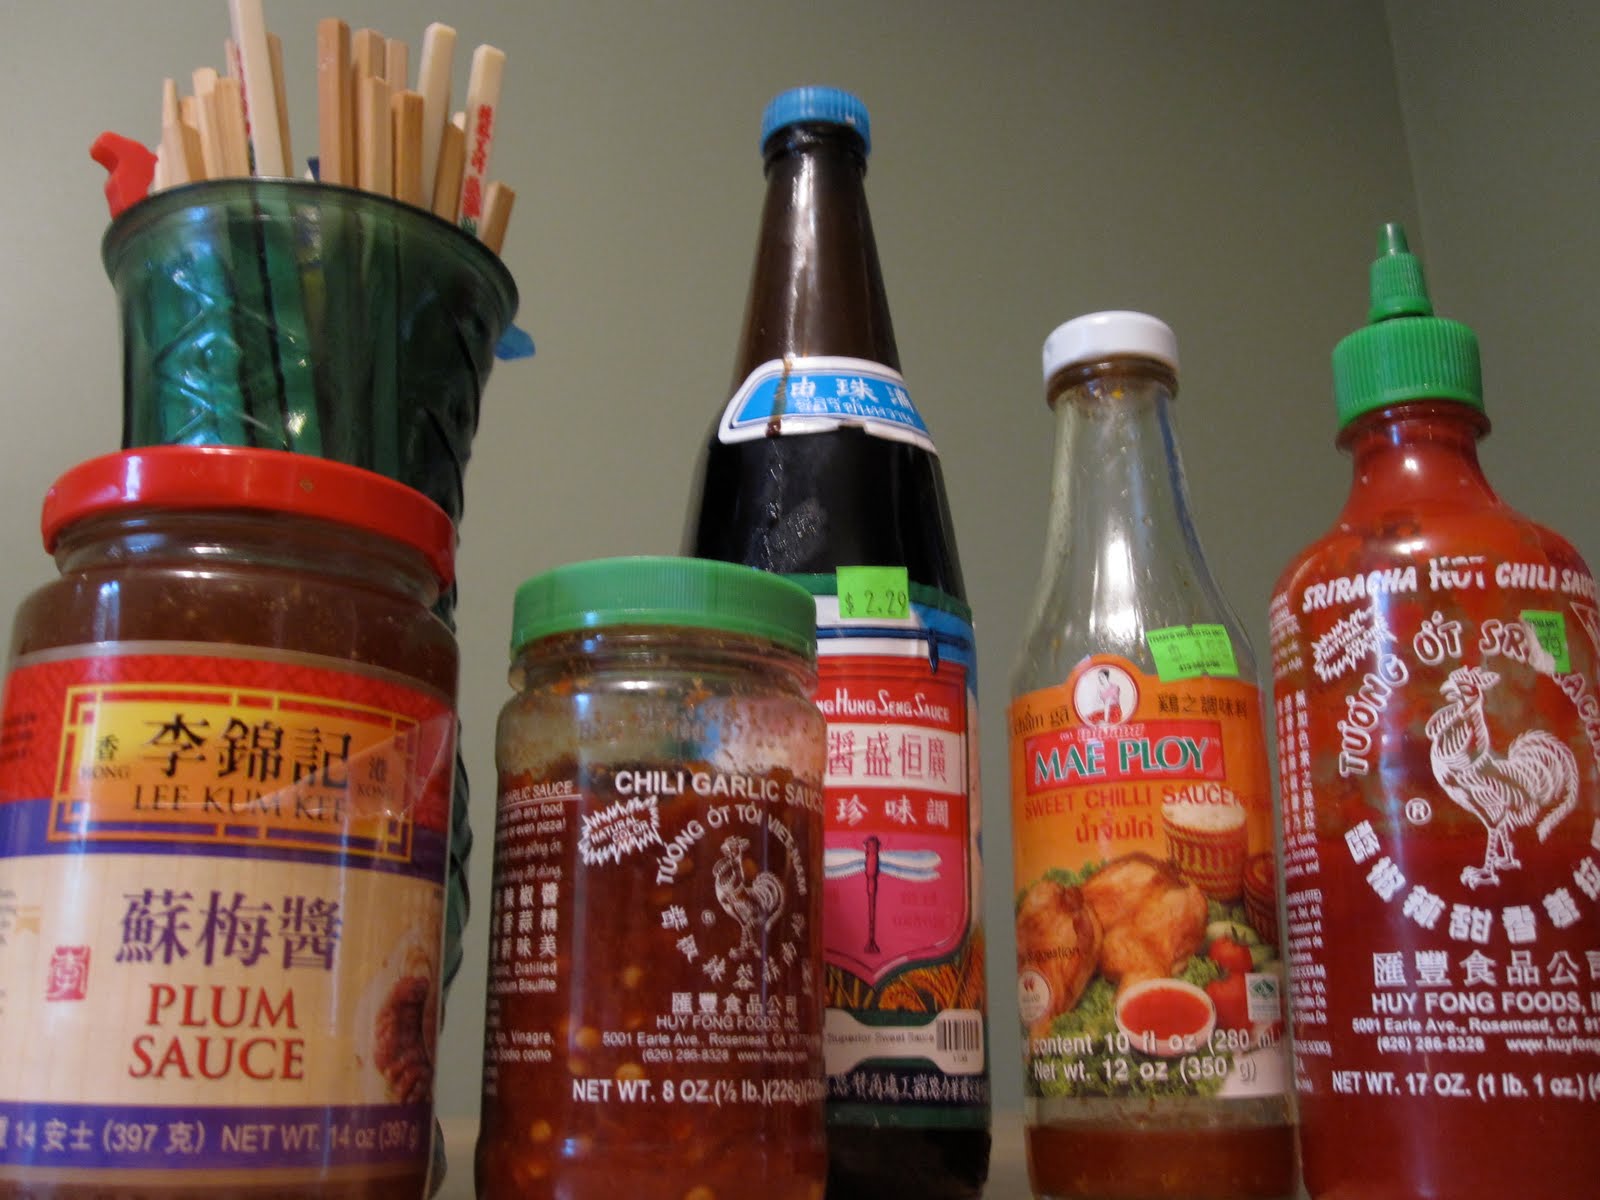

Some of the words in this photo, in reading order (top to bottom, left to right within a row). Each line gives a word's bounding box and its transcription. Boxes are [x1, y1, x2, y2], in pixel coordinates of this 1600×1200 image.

[1302, 565, 1419, 613] SRIRACHA
[1429, 556, 1487, 592] HOT
[1495, 562, 1556, 591] CHILI
[142, 713, 352, 789] 李錦記
[1035, 738, 1106, 786] MAE
[1117, 735, 1210, 774] PLOY
[135, 783, 189, 812] LEE
[203, 786, 282, 818] KUM
[615, 770, 685, 795] CHILI
[691, 772, 781, 803] GARLIC
[1024, 791, 1074, 823] SWEET
[1083, 783, 1152, 809] CHILLI
[1161, 782, 1232, 806] SAUCE
[115, 887, 342, 970] 蘇梅醬
[515, 961, 557, 977] Distilled
[147, 982, 299, 1029] PLUM
[1371, 992, 1417, 1015] HUY
[1424, 991, 1496, 1014] FONG
[1501, 991, 1586, 1015] FOODS,
[602, 1031, 632, 1047] 5001
[637, 1031, 670, 1047] Earle
[656, 1015, 688, 1031] HUY
[692, 1015, 734, 1031] FONG
[1352, 1017, 1381, 1034] 5001
[1384, 1017, 1422, 1034] Earle
[1469, 1018, 1554, 1036] Rosemead,
[1556, 1018, 1579, 1034] CA
[128, 1035, 305, 1080] SAUCE
[642, 1048, 673, 1064] (626)
[1105, 1031, 1130, 1053] 10
[1169, 1035, 1197, 1051] oz
[1207, 1028, 1249, 1057] (280
[1033, 1057, 1057, 1080] Net
[1063, 1058, 1092, 1081] wt.
[1103, 1058, 1129, 1080] 12
[1139, 1063, 1169, 1081] oz
[1179, 1056, 1230, 1085] (350
[1239, 1057, 1258, 1083] g)
[1331, 1070, 1362, 1094] NET
[1364, 1071, 1400, 1096] WT.
[1404, 1072, 1428, 1095] 17
[1434, 1072, 1472, 1097] OZ.
[1477, 1072, 1495, 1103] (1
[1502, 1072, 1529, 1097] lb.
[1532, 1072, 1546, 1096] 1
[1549, 1072, 1584, 1101] oz.)
[572, 1078, 612, 1102] NET
[616, 1078, 656, 1102] WT.
[662, 1079, 674, 1102] 8
[15, 1120, 36, 1149] 14
[43, 1117, 94, 1152] 安士
[102, 1118, 159, 1152] (397
[221, 1121, 275, 1152] NET
[280, 1122, 321, 1151] WT.
[330, 1122, 350, 1149] 14
